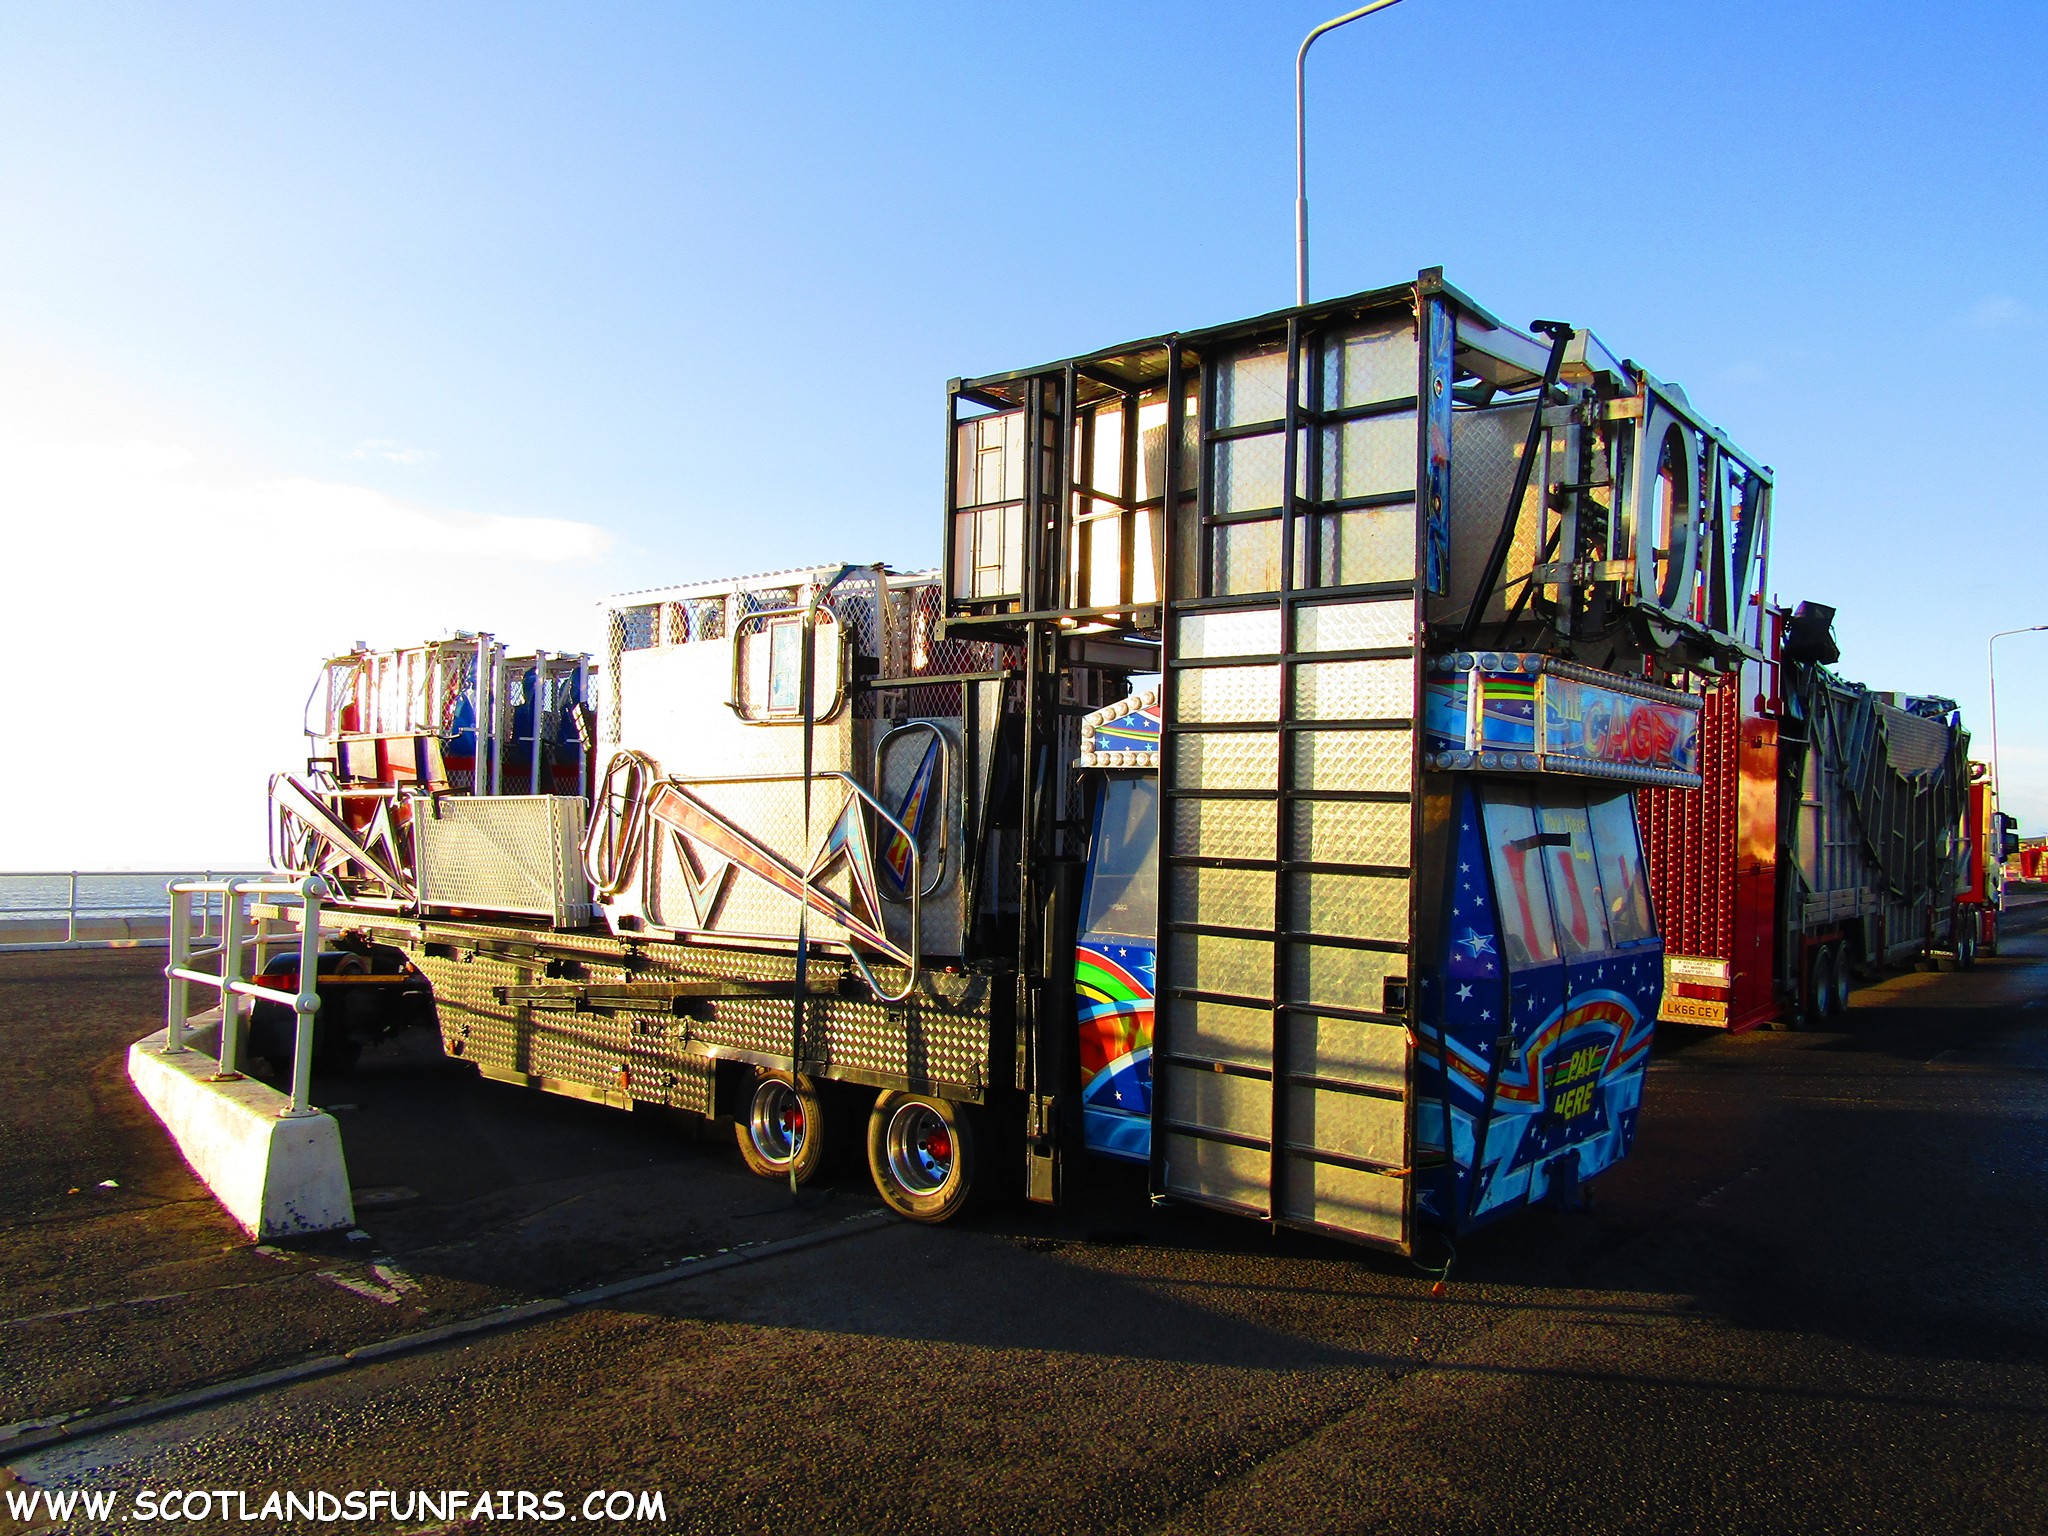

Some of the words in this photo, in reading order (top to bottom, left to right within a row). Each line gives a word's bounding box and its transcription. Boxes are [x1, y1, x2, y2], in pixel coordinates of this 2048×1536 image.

[1583, 698, 1679, 767] CAGE
[1668, 1003, 1695, 1015] LK66
[1698, 1007, 1719, 1017] CEY
[1567, 1044, 1599, 1083] PAY
[1554, 1081, 1595, 1120] HERE
